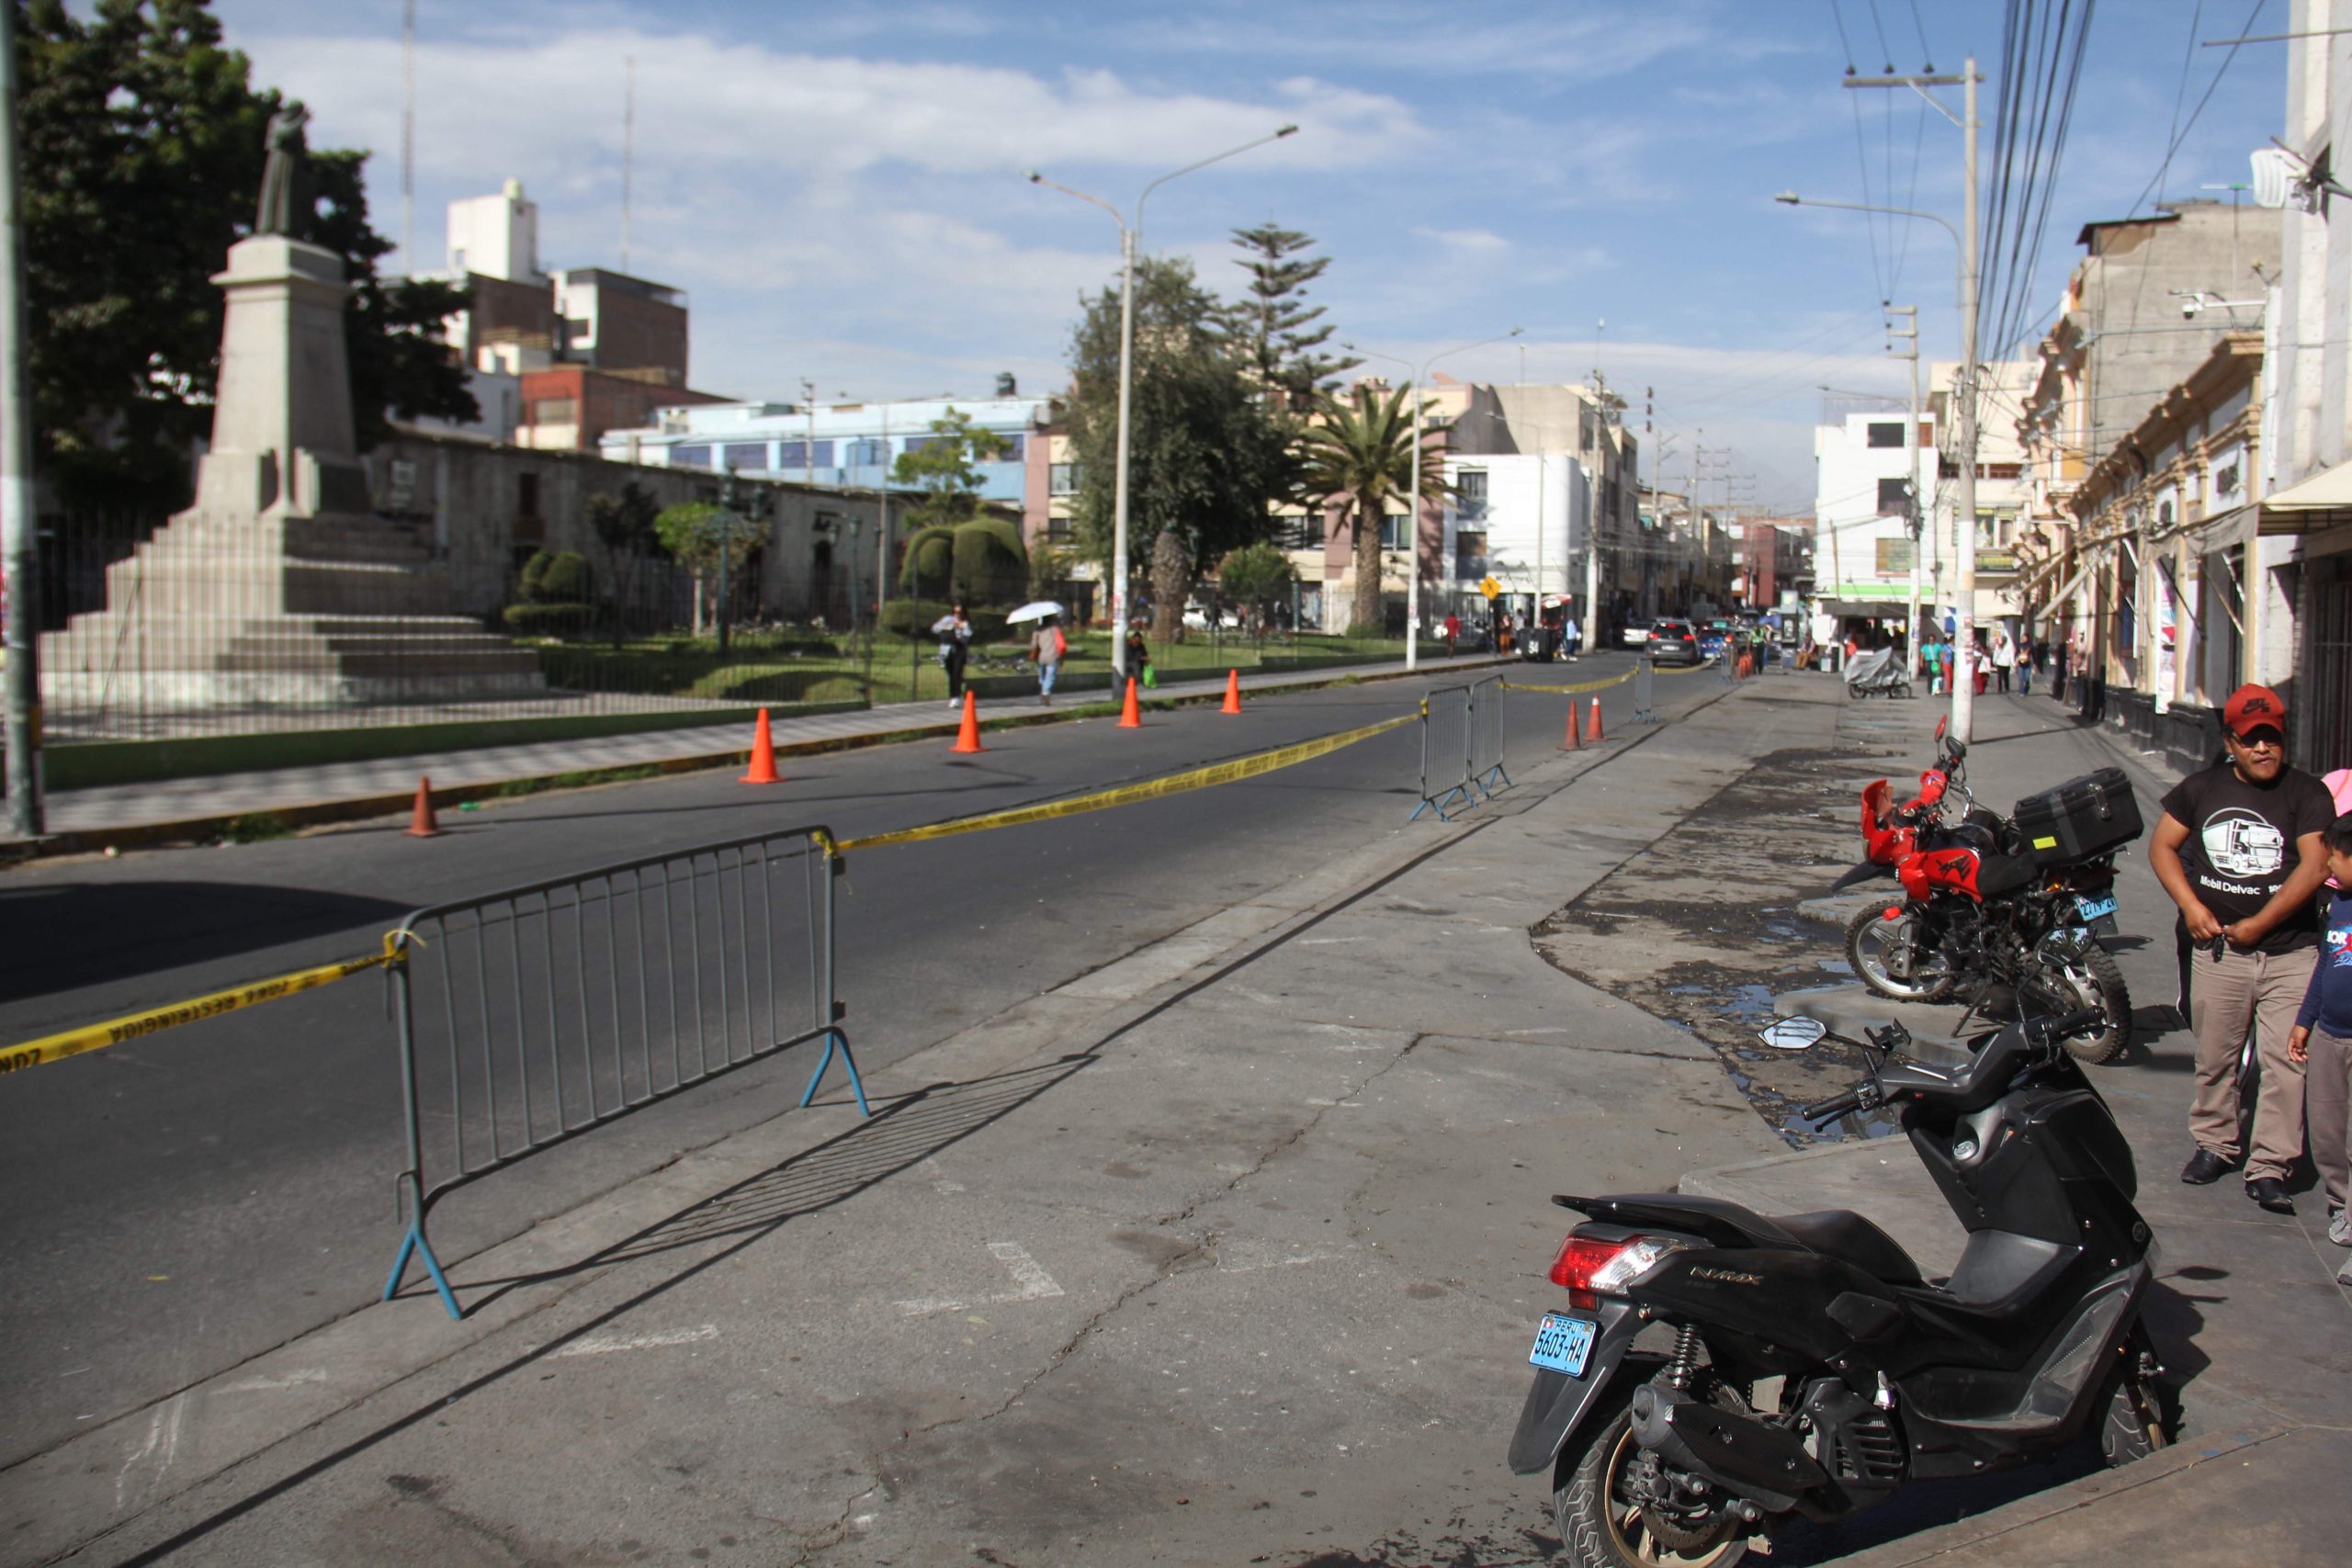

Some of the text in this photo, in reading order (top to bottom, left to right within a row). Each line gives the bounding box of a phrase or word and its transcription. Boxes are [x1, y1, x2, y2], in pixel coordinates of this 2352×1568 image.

[2199, 875, 2222, 891] Mobil
[2222, 883, 2261, 896] Delvac
[1555, 1320, 1579, 1334] PERU
[1534, 1329, 1586, 1365] 5603-HA
